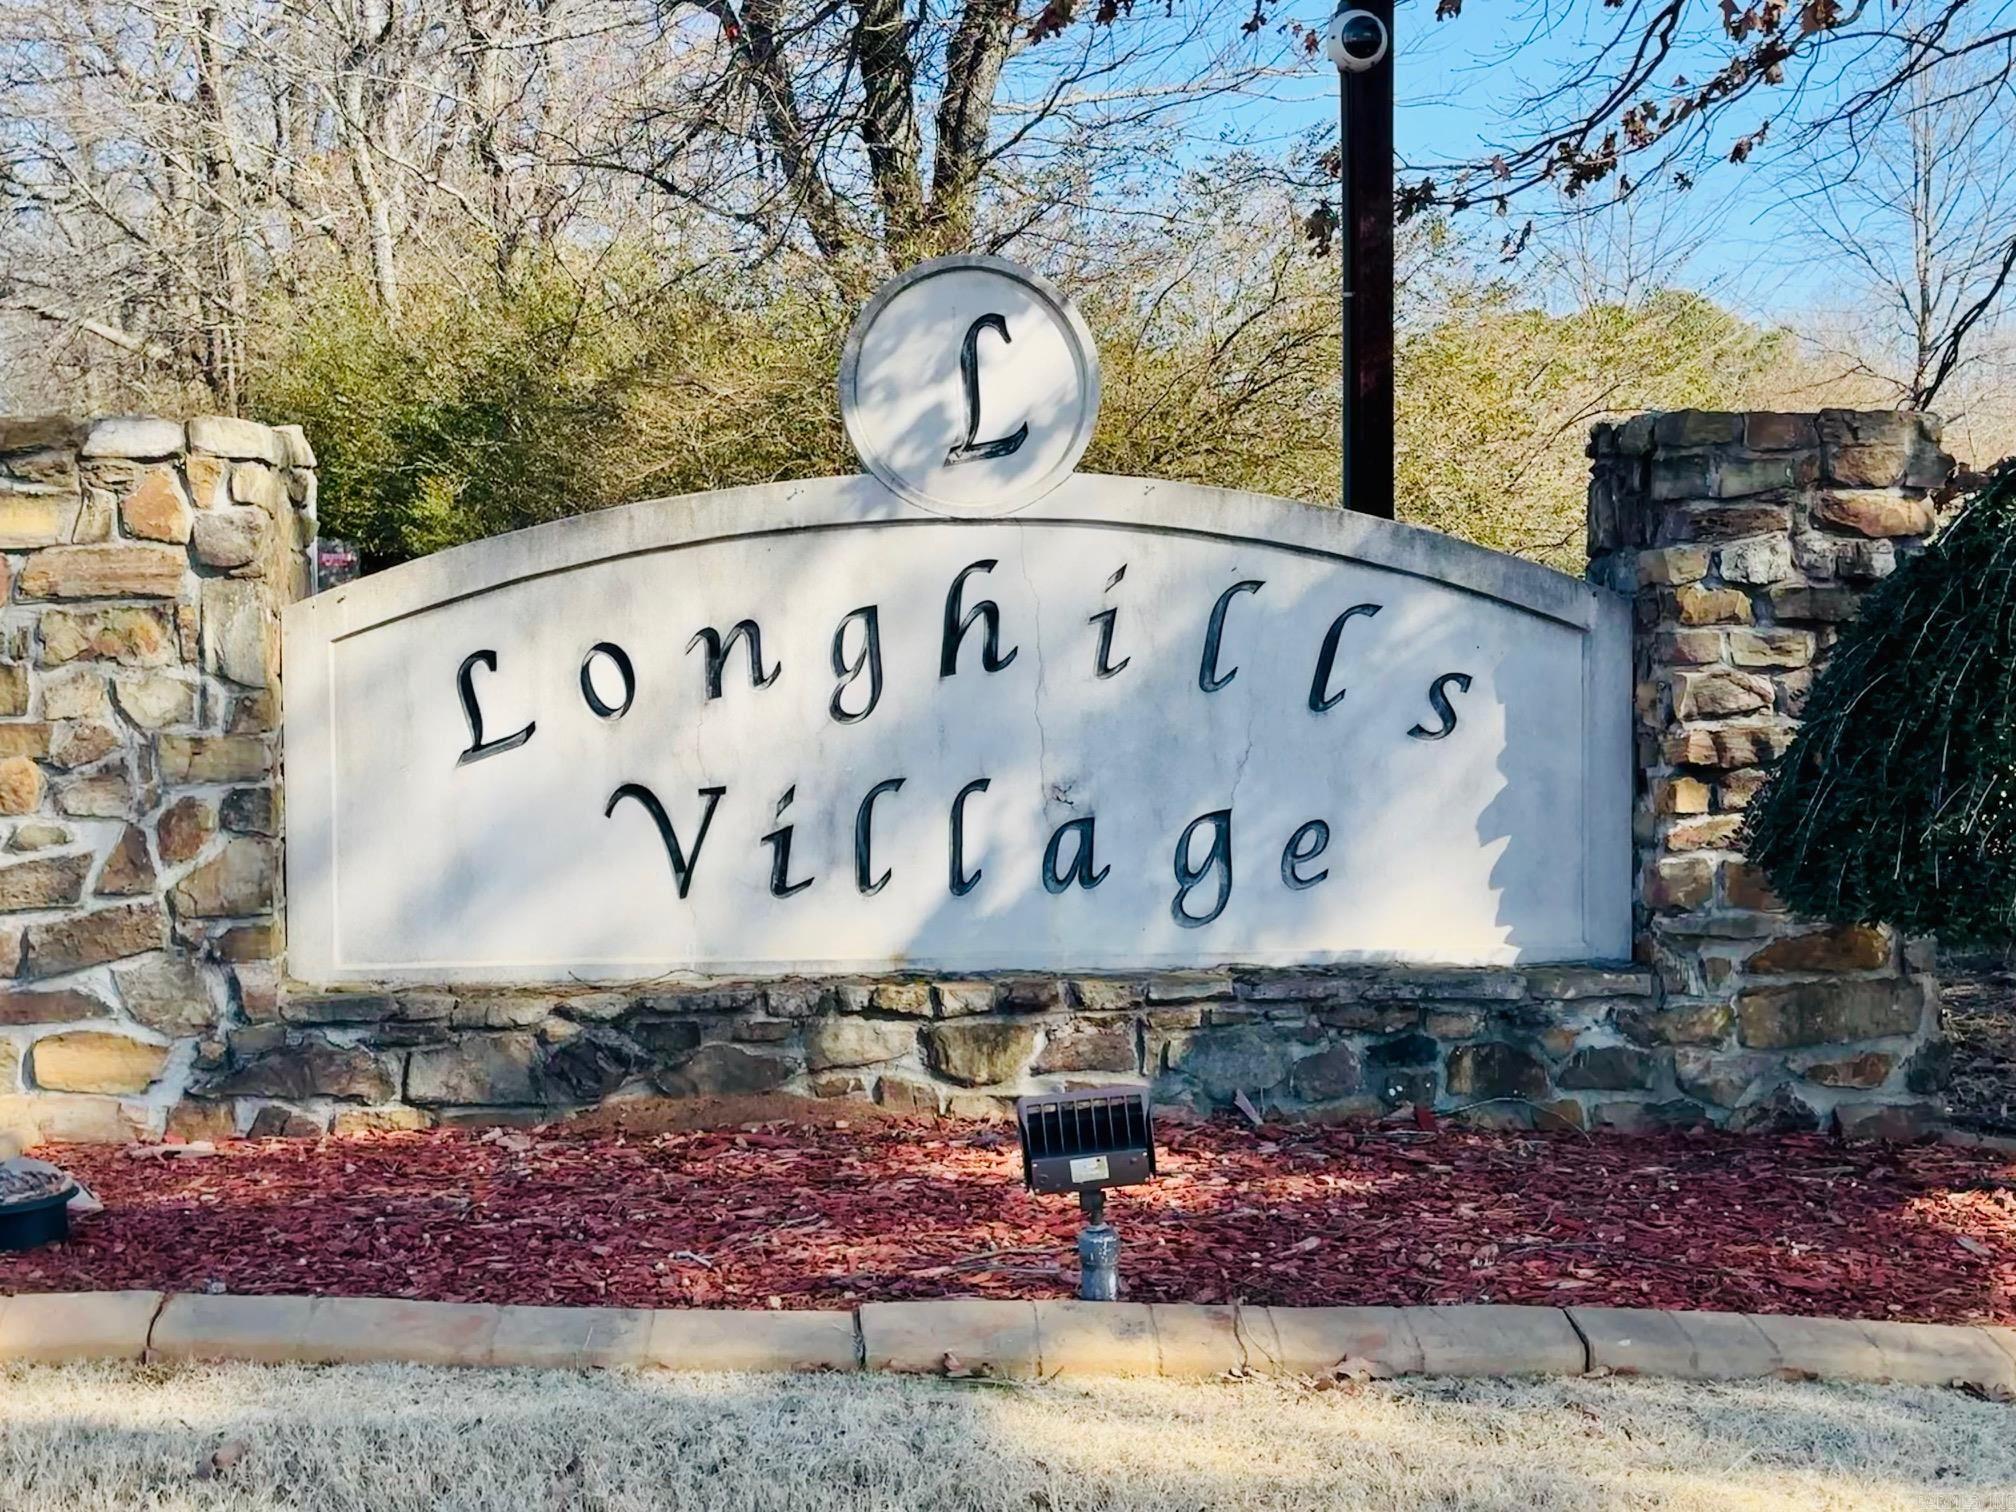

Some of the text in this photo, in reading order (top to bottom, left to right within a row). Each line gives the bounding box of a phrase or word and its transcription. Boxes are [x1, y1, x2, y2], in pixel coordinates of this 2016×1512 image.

[943, 312, 1029, 468] L
[456, 558, 1473, 768] Longhills
[604, 776, 1331, 929] Village
